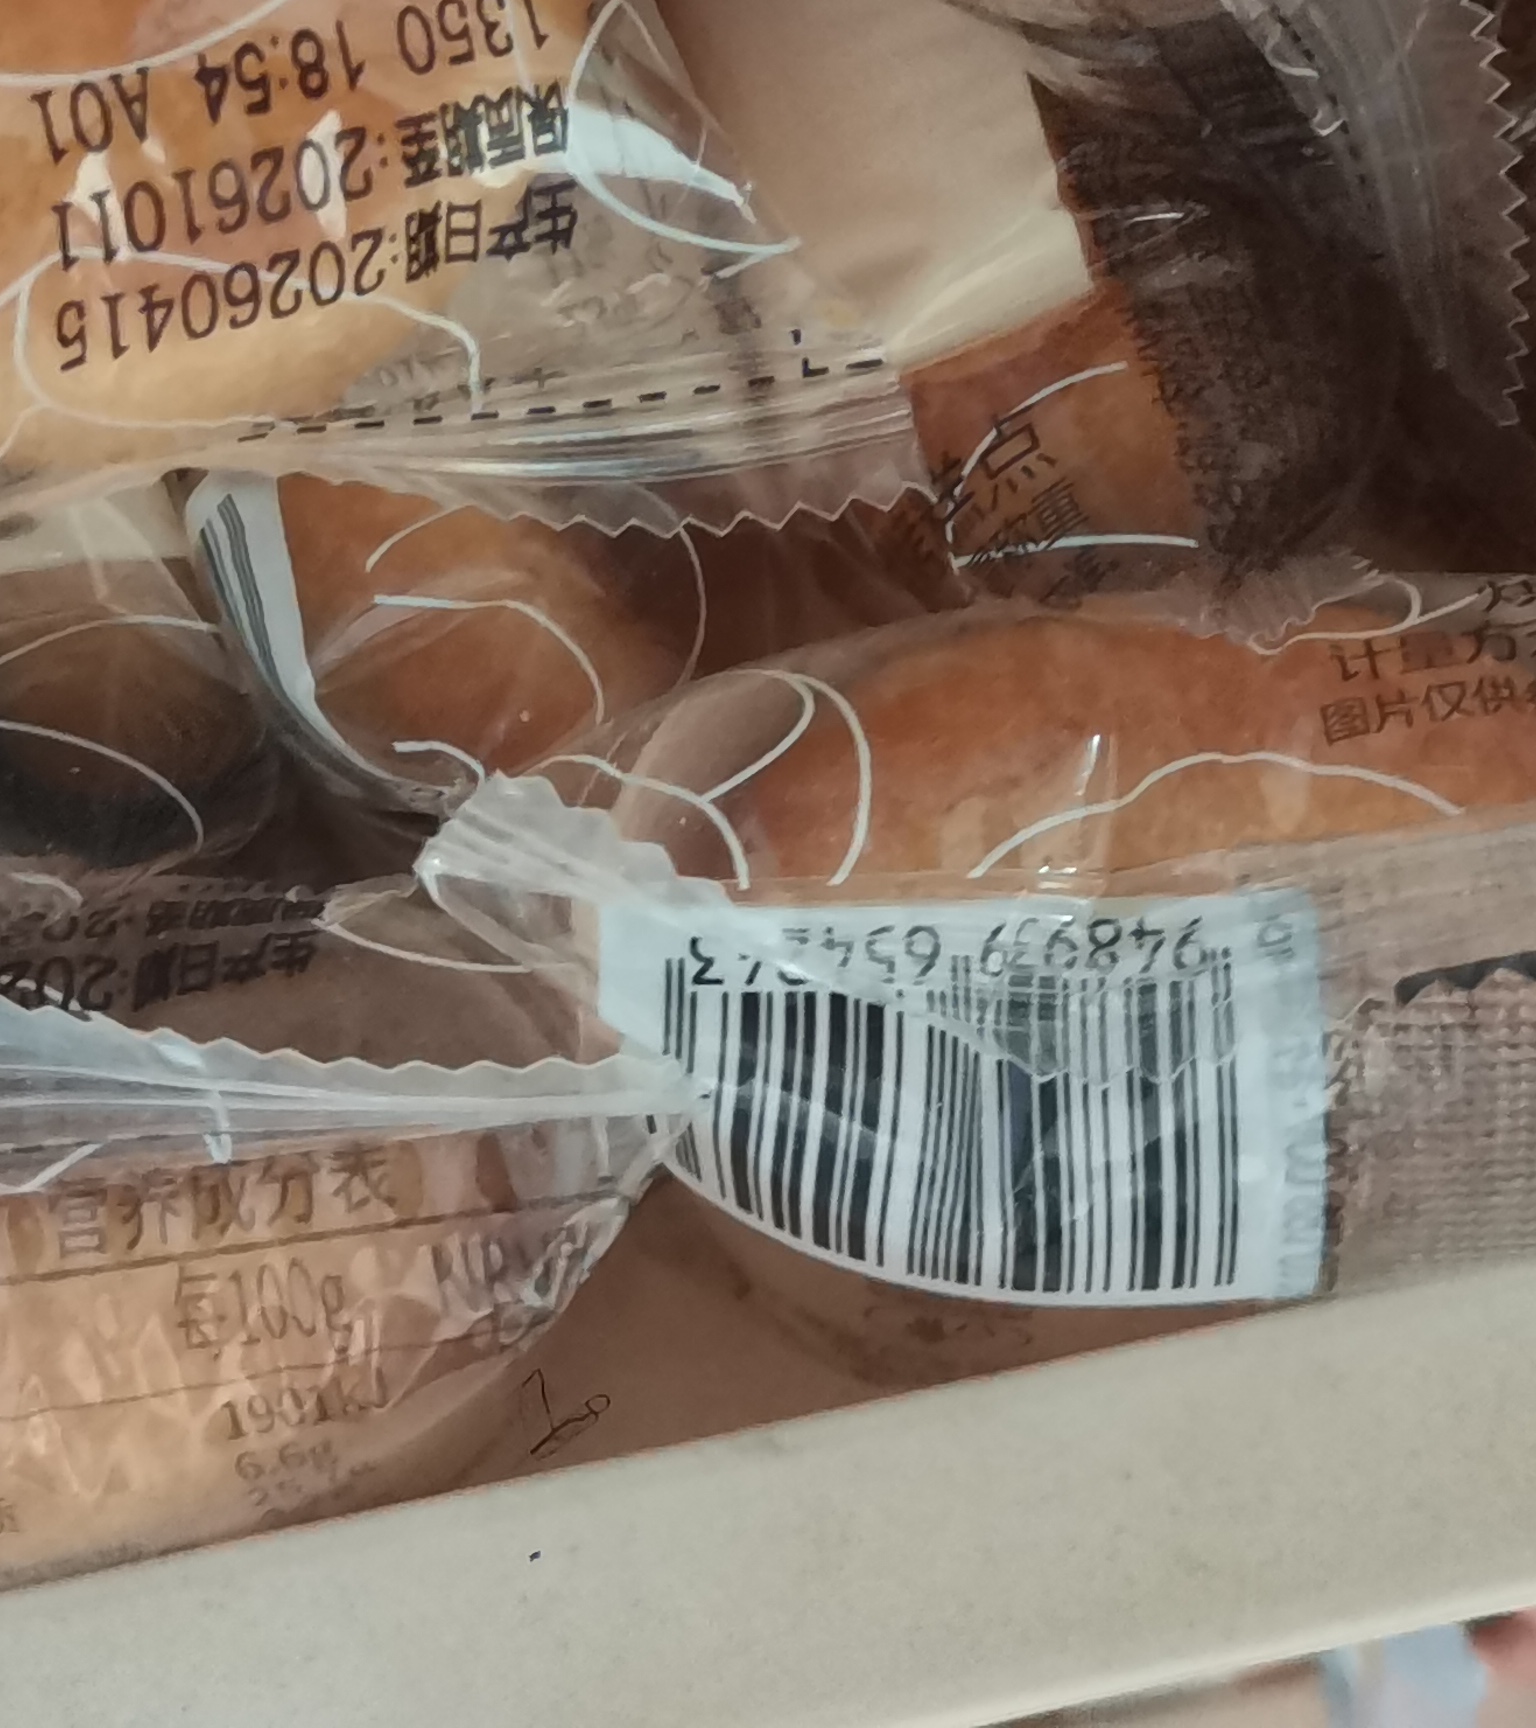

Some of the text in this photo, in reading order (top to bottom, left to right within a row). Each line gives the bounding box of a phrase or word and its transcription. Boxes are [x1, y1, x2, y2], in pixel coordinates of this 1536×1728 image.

[26, 66, 151, 165] A01
[194, 18, 368, 127] 18:54
[53, 178, 582, 373] 生产日期:20260415
[52, 1141, 399, 1259] 营养成分表
